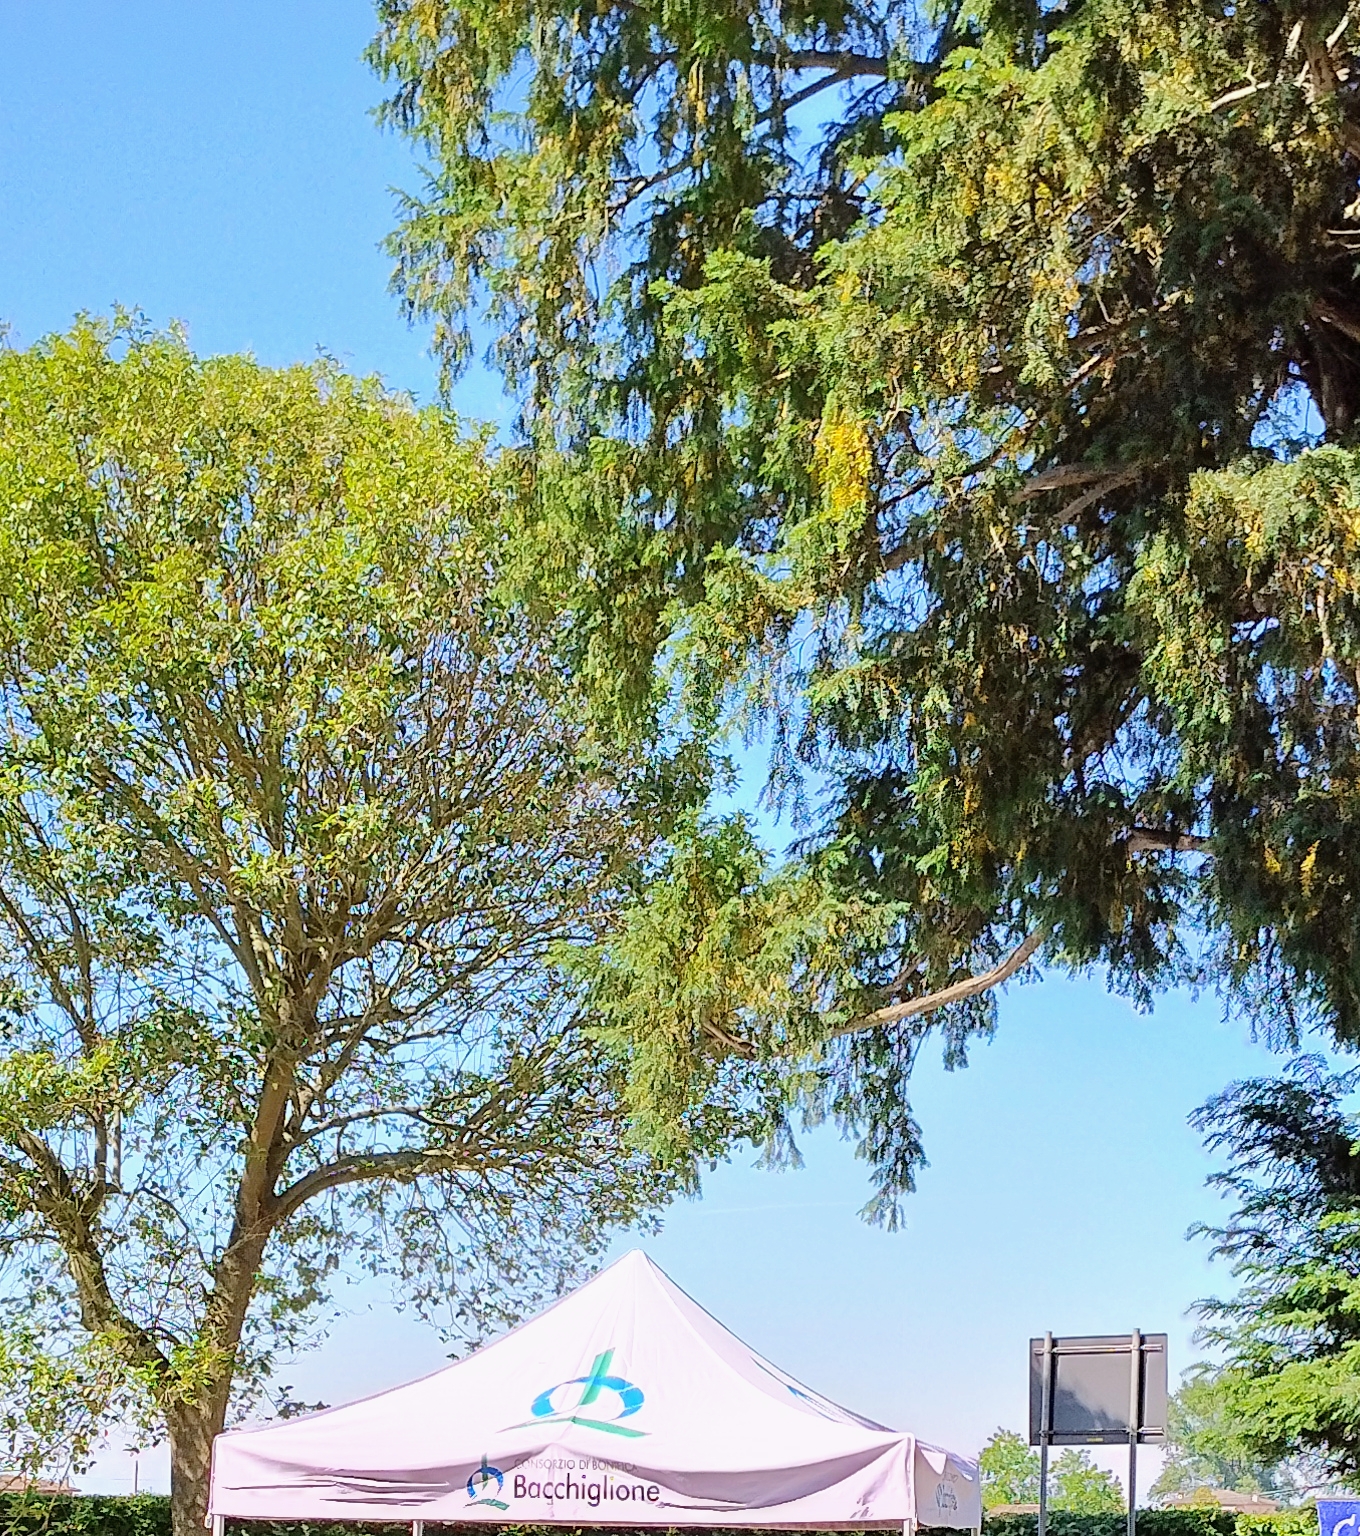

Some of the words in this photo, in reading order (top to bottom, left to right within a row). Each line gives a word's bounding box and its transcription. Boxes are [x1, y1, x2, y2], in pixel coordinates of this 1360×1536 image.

[513, 1458, 576, 1470] CONSORZIO
[578, 1459, 589, 1470] DI
[513, 1472, 660, 1507] Bacchiglione
